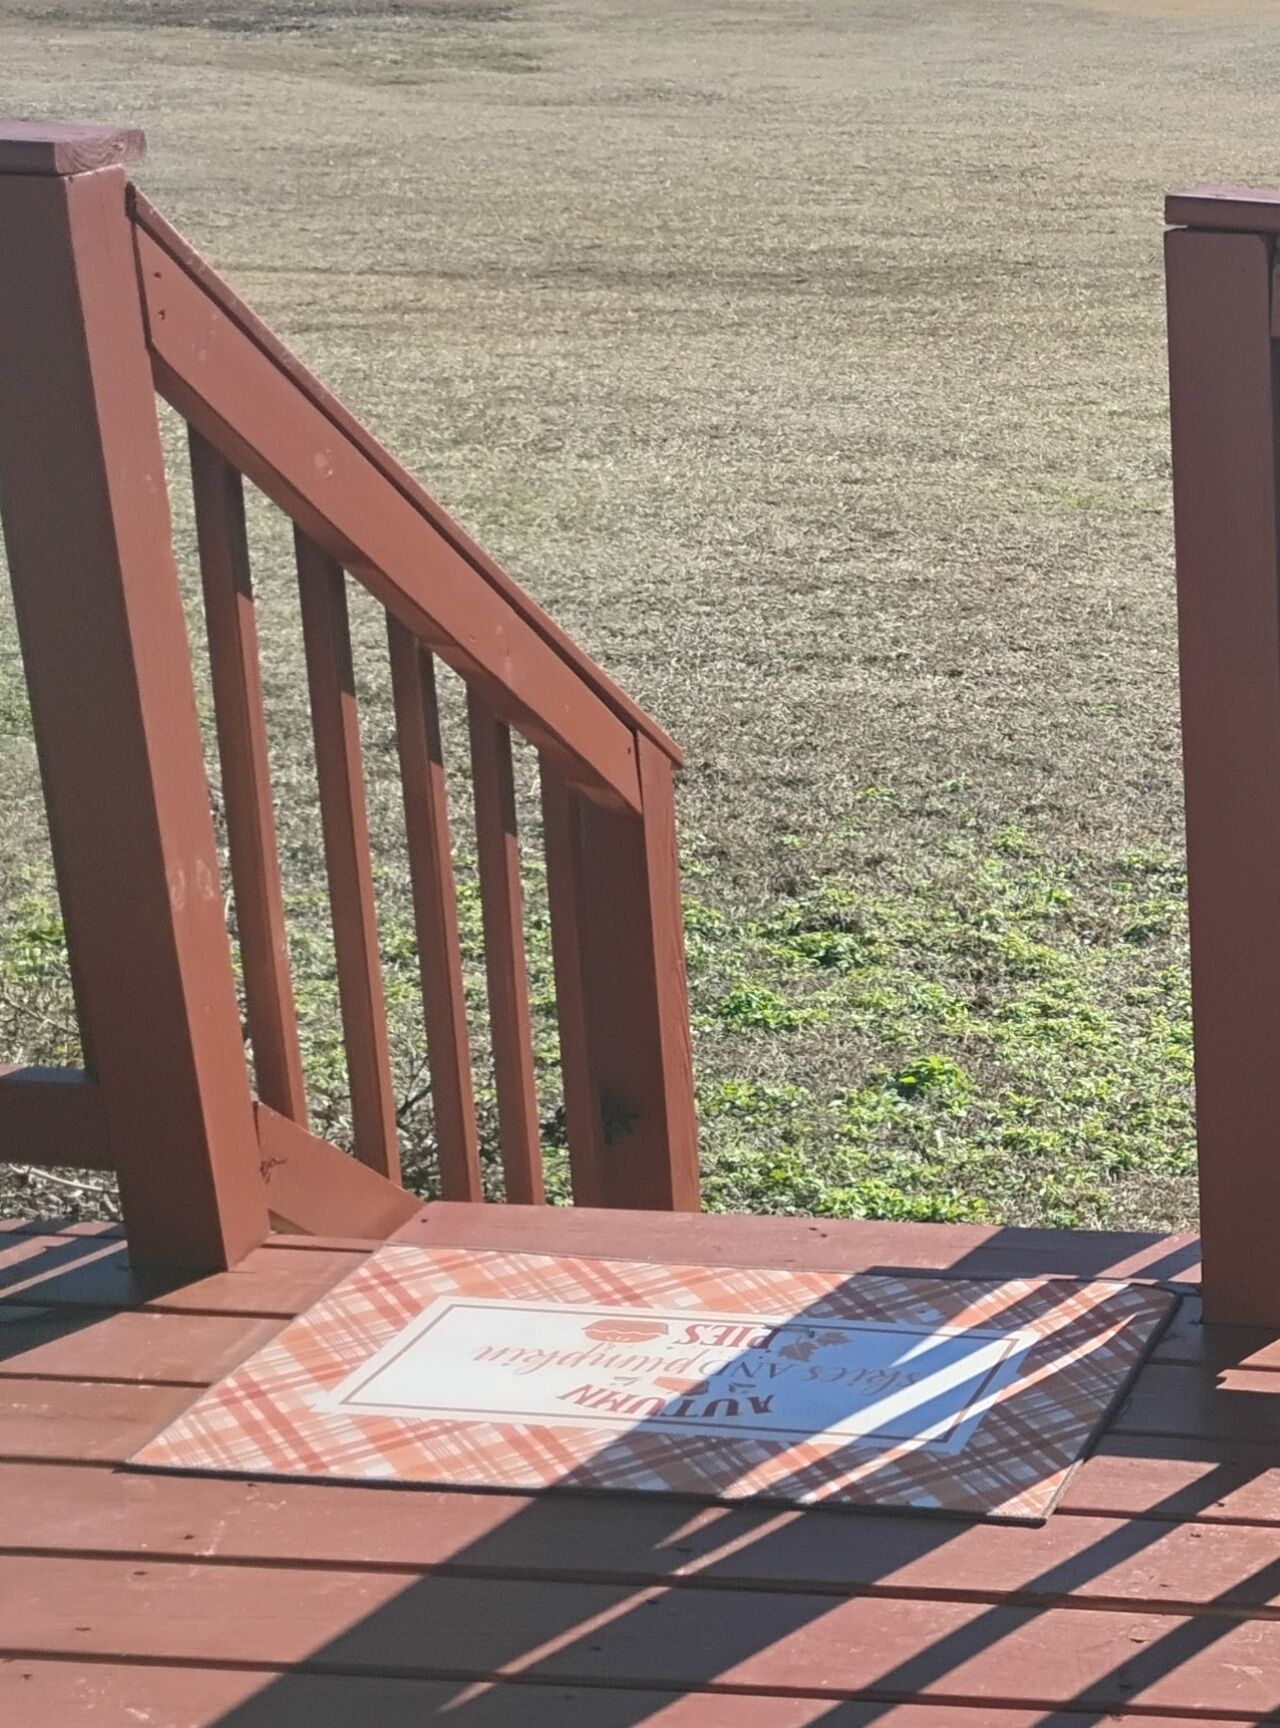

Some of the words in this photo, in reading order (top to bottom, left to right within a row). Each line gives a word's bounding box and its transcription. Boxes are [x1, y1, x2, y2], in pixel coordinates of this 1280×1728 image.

[672, 1323, 781, 1349] PIES
[473, 1342, 711, 1376] pumpkin
[698, 1360, 797, 1379] AND
[803, 1365, 922, 1396] skies
[556, 1383, 776, 1418] AUTUMN
